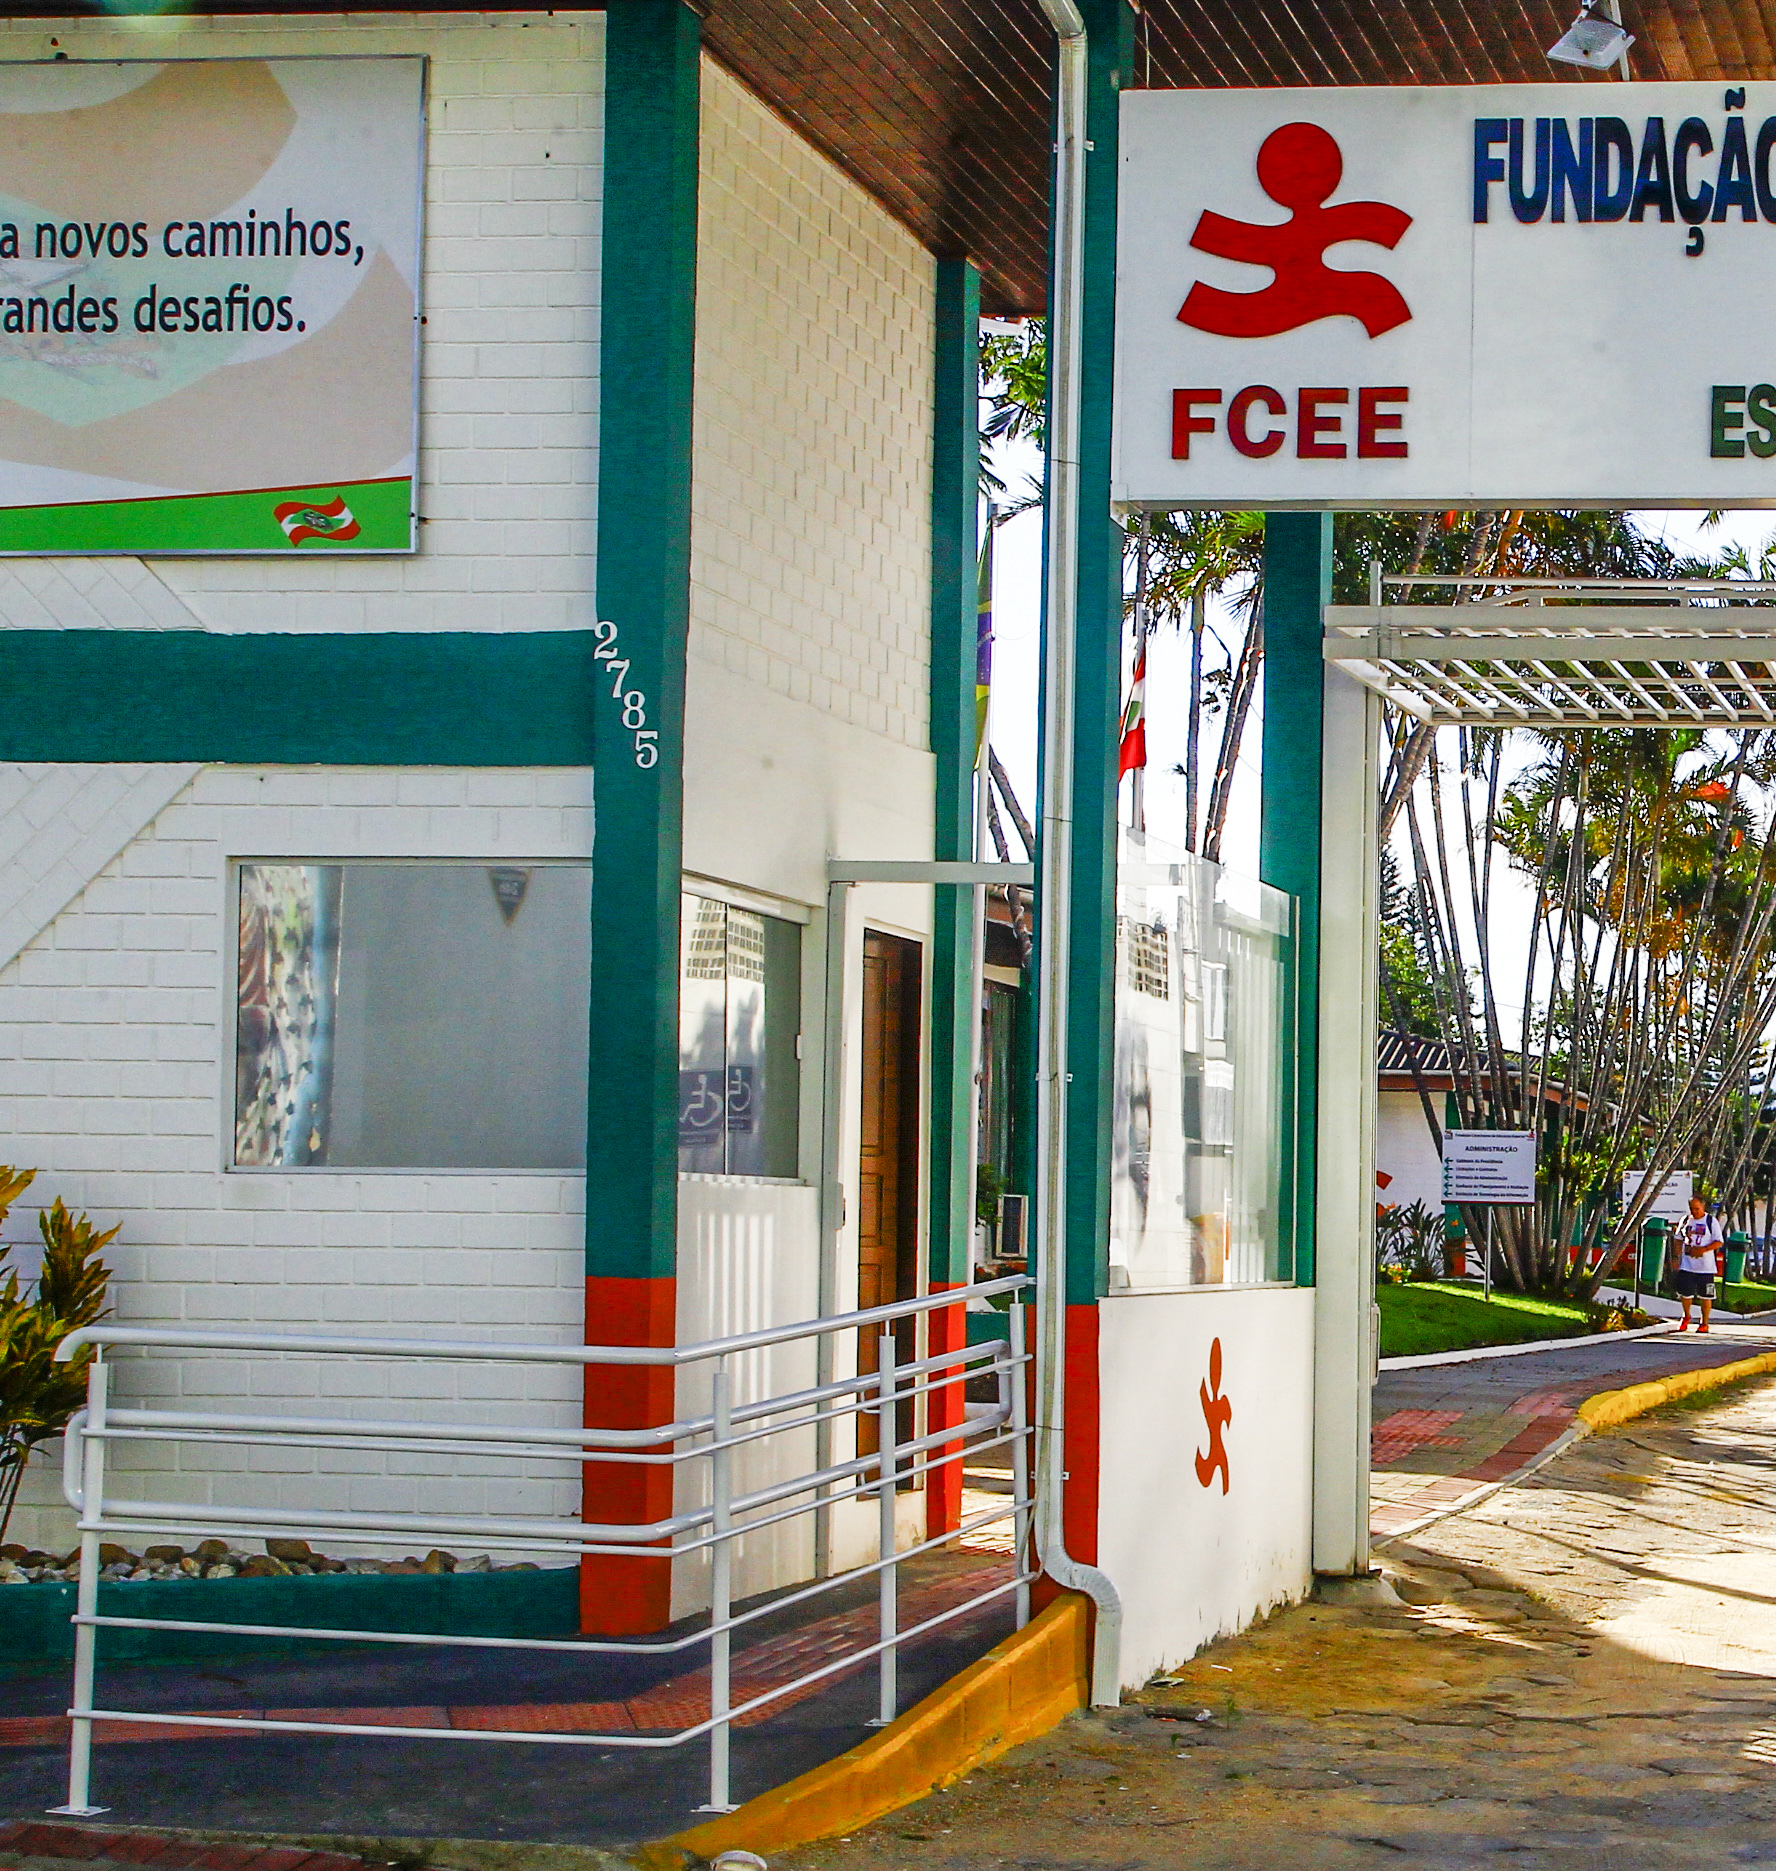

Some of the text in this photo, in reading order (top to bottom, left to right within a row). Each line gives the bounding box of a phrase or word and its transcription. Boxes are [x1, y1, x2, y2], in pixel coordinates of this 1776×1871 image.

[36, 222, 149, 259] novos
[163, 208, 365, 267] caminhos,
[134, 283, 307, 333] desafios.
[1172, 385, 1410, 461] FCEE
[593, 620, 659, 769] 2785
[1464, 1145, 1518, 1153] ADMINISTRAÇÃO
